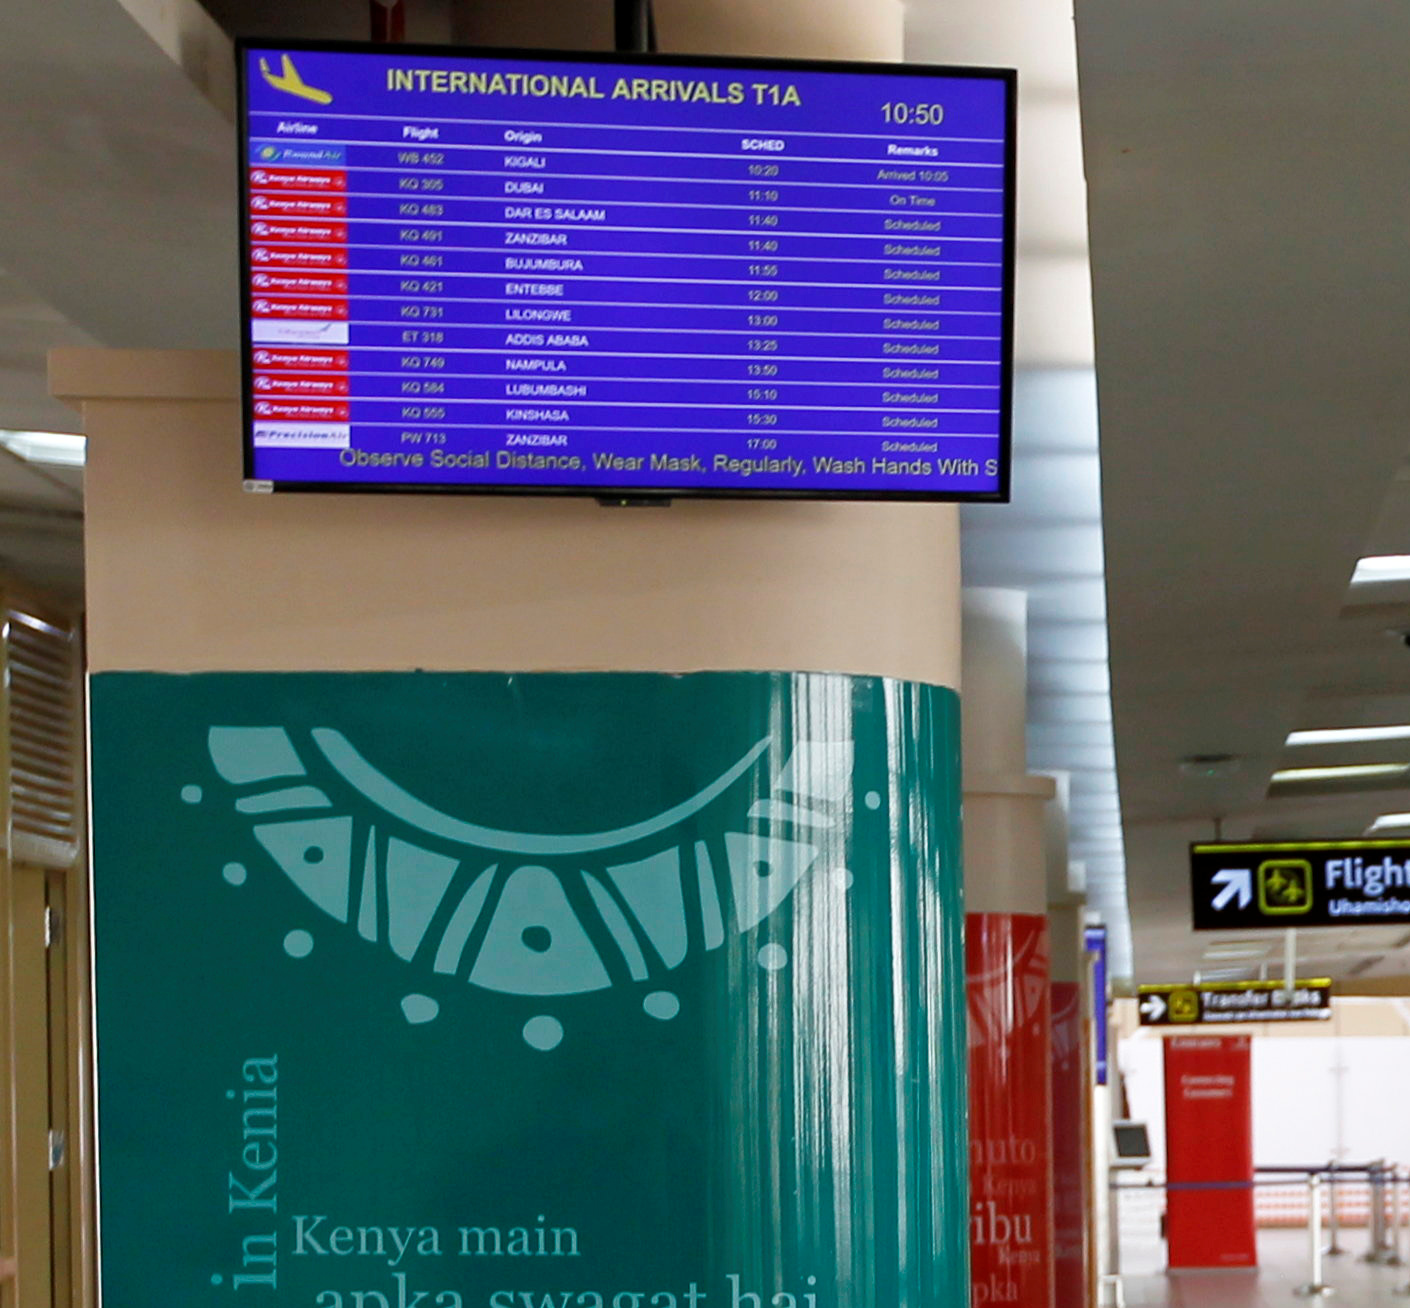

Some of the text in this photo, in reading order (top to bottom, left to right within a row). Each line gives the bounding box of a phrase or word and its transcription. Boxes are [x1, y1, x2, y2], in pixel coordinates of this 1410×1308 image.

[388, 69, 801, 106] INTERNATIONAL ARRIVALS T1A
[882, 103, 943, 125] 10:50
[402, 126, 439, 142] Flight
[504, 130, 542, 144] Origin
[742, 139, 784, 151] SCHED
[888, 144, 938, 156] Remarks
[505, 156, 545, 168] KIGALI
[400, 178, 418, 189] KQ
[505, 181, 544, 193] DUBAI
[749, 190, 778, 201] 11:10
[890, 195, 906, 205] On
[910, 195, 935, 206] Time
[400, 204, 419, 215] KQ
[505, 207, 532, 218] DAR
[535, 208, 552, 219] ES
[555, 208, 605, 220] SALAAM
[749, 215, 778, 226] 11:40
[884, 219, 941, 231] Scheduled
[400, 230, 419, 240] KQ
[505, 232, 567, 245] ZANZIBAR
[749, 241, 778, 251] 11:40
[884, 244, 940, 256] Scheduled
[400, 255, 419, 266] KQ
[505, 257, 583, 270] BUJUMBURA
[884, 269, 940, 280] Scheduled
[401, 281, 420, 291] KQ
[506, 283, 563, 296] ENTEBBE
[884, 294, 940, 305] Scheduled
[401, 306, 420, 317] KQ
[506, 309, 571, 321] LILONGWE
[884, 319, 939, 330] Scheduled
[402, 331, 418, 342] ET
[505, 333, 544, 345] ADDIS
[547, 335, 589, 346] ABABA
[883, 343, 939, 354] Scheduled
[402, 357, 420, 368] KQ
[506, 359, 566, 371] NAMPULA
[883, 368, 939, 379] Scheduled
[402, 382, 420, 393] KQ
[506, 384, 586, 396] LUBUMBASHI
[882, 392, 938, 403] Scheduled
[402, 408, 421, 418] KQ
[506, 410, 569, 421] KINSHASA
[882, 416, 938, 427] Scheduled
[401, 432, 422, 443] PW
[506, 434, 567, 446] ZANZIBAR
[882, 441, 937, 452] Scheduled
[340, 448, 997, 477] Observe Social Distance, Wear Mask, Regularly, Wash Hands With S
[225, 1054, 278, 1214] Kenia
[971, 1201, 1033, 1245] ibu
[292, 1214, 581, 1266] Kenya main
[211, 1231, 278, 1291] in
